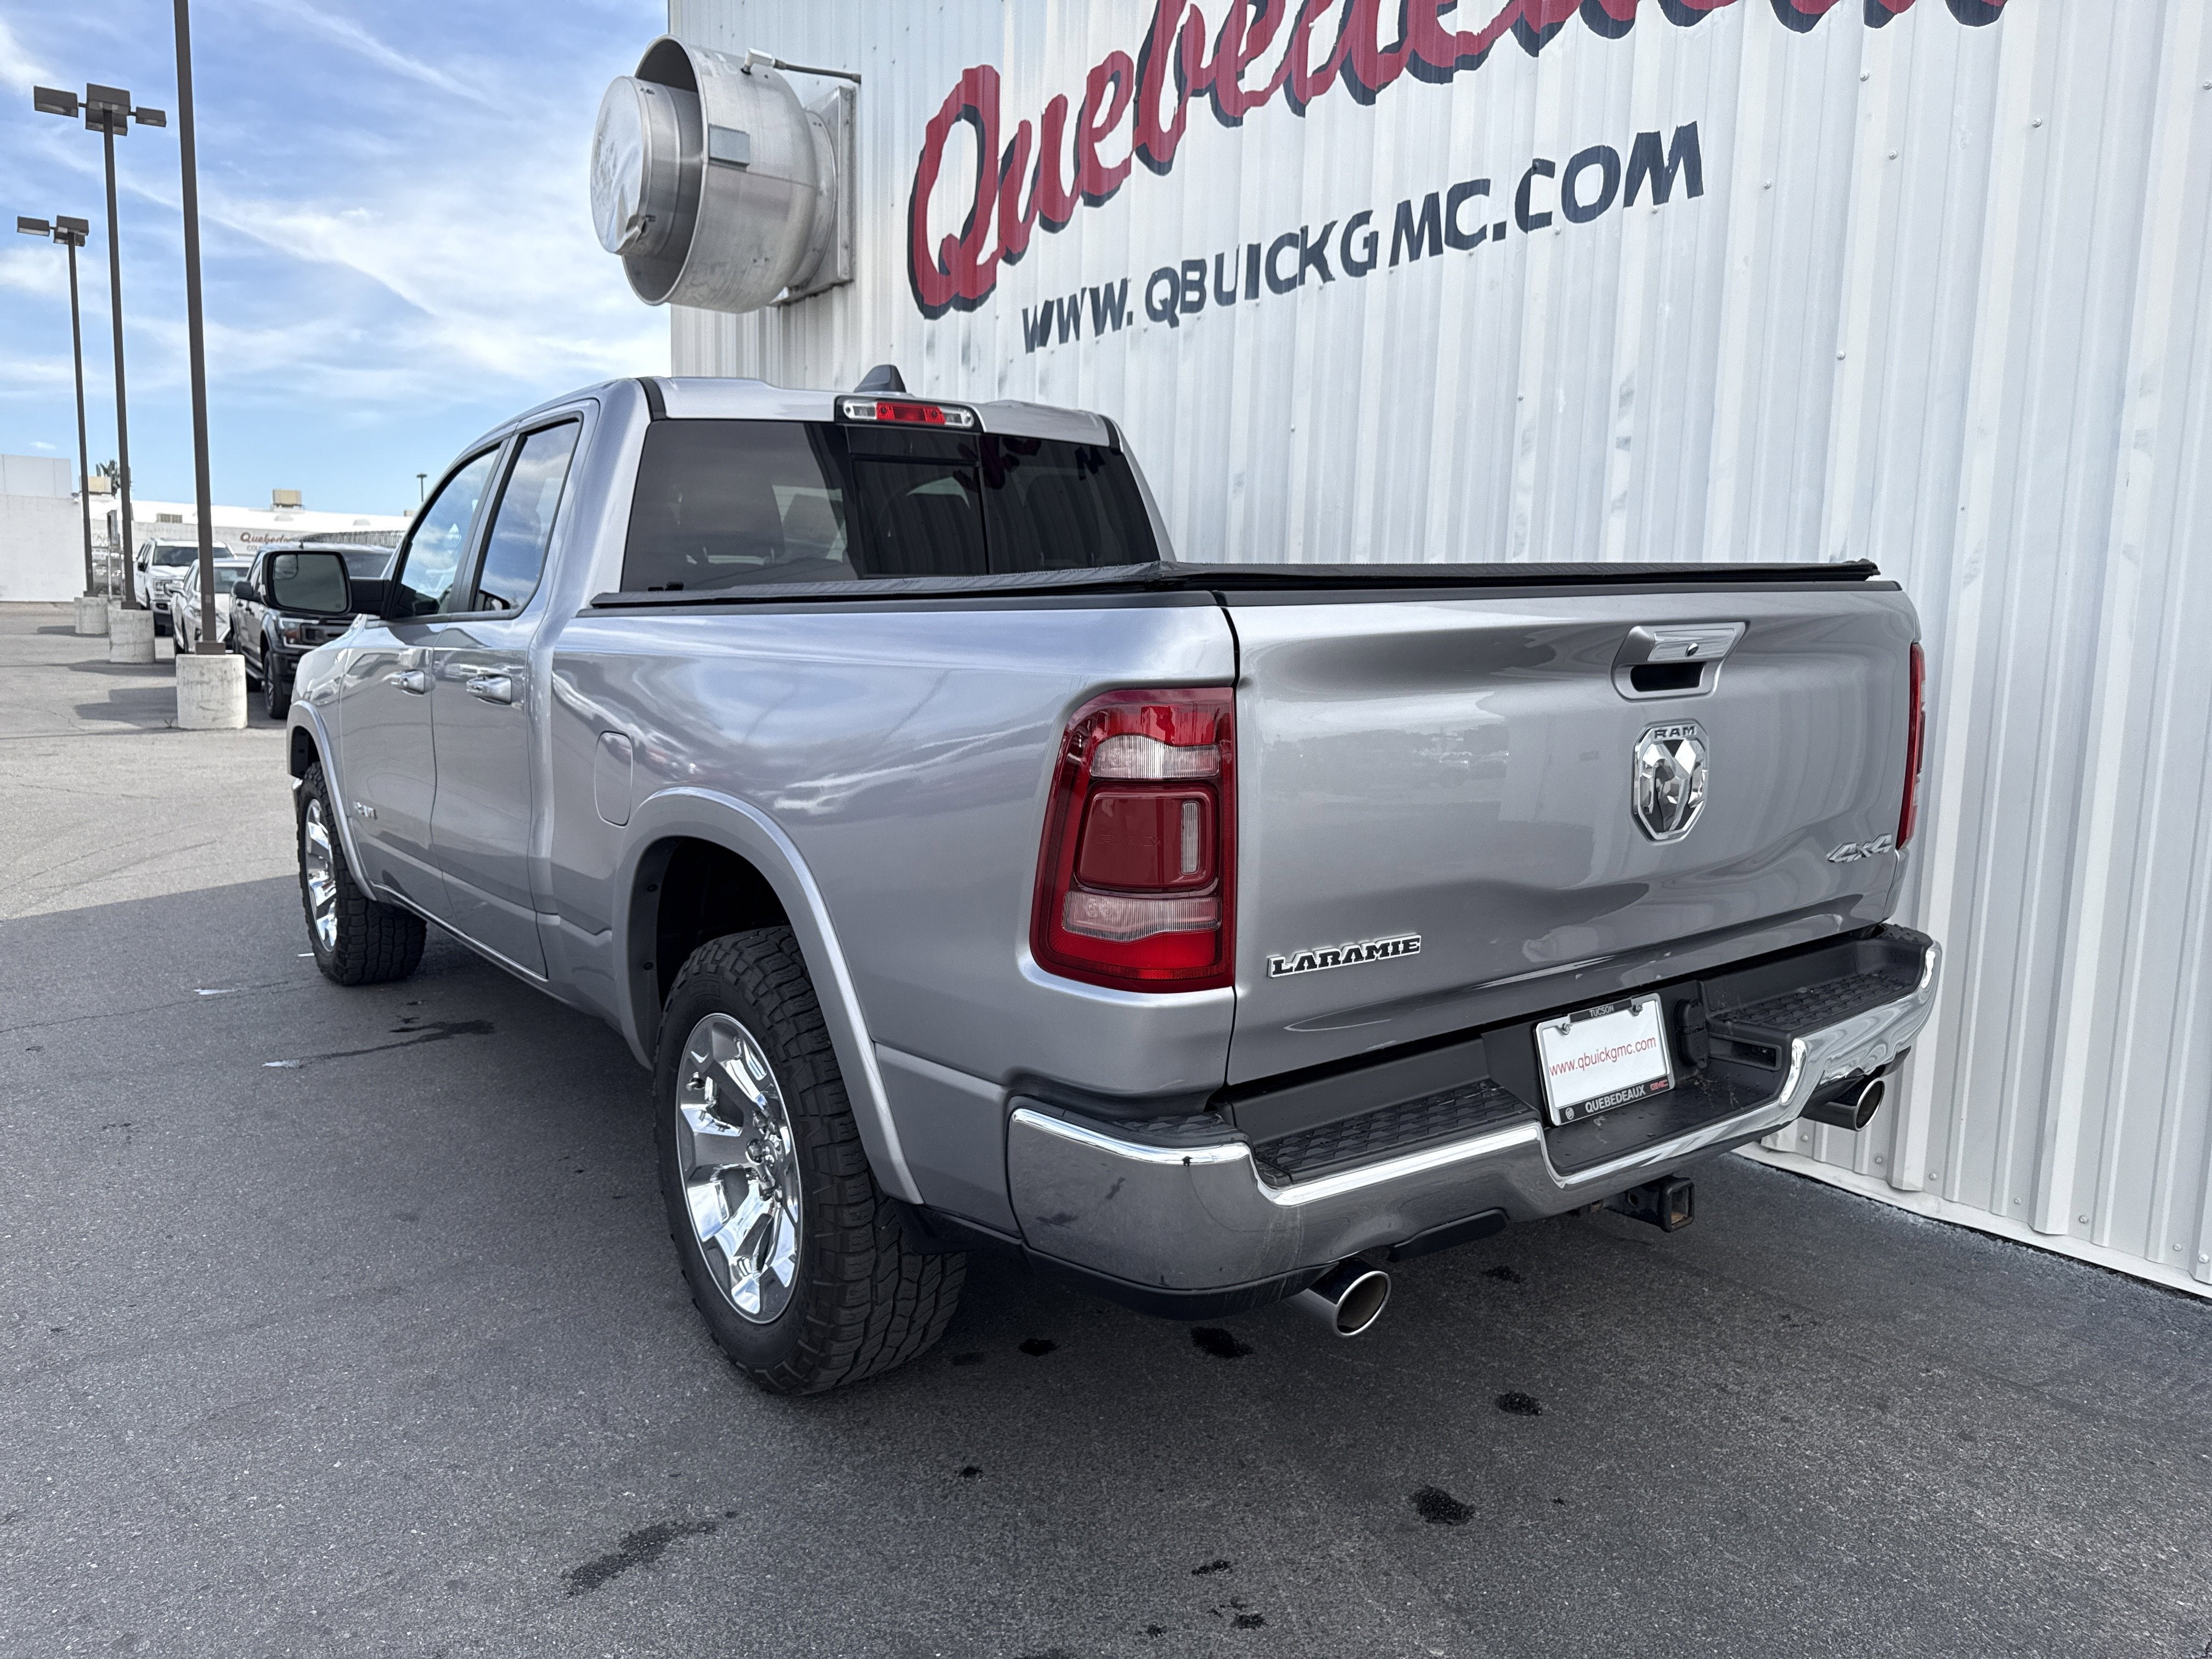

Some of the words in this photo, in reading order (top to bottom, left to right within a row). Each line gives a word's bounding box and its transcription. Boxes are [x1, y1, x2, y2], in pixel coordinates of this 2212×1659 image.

[1654, 726, 1695, 739] RAM
[1268, 934, 1421, 978] LARAMIE
[1589, 1005, 1615, 1018] TUCSON
[1549, 1037, 1656, 1076] www.qbuickgmc.com
[1584, 1084, 1646, 1113] QUEBEDEAUX
[1650, 1079, 1669, 1091] GMC
